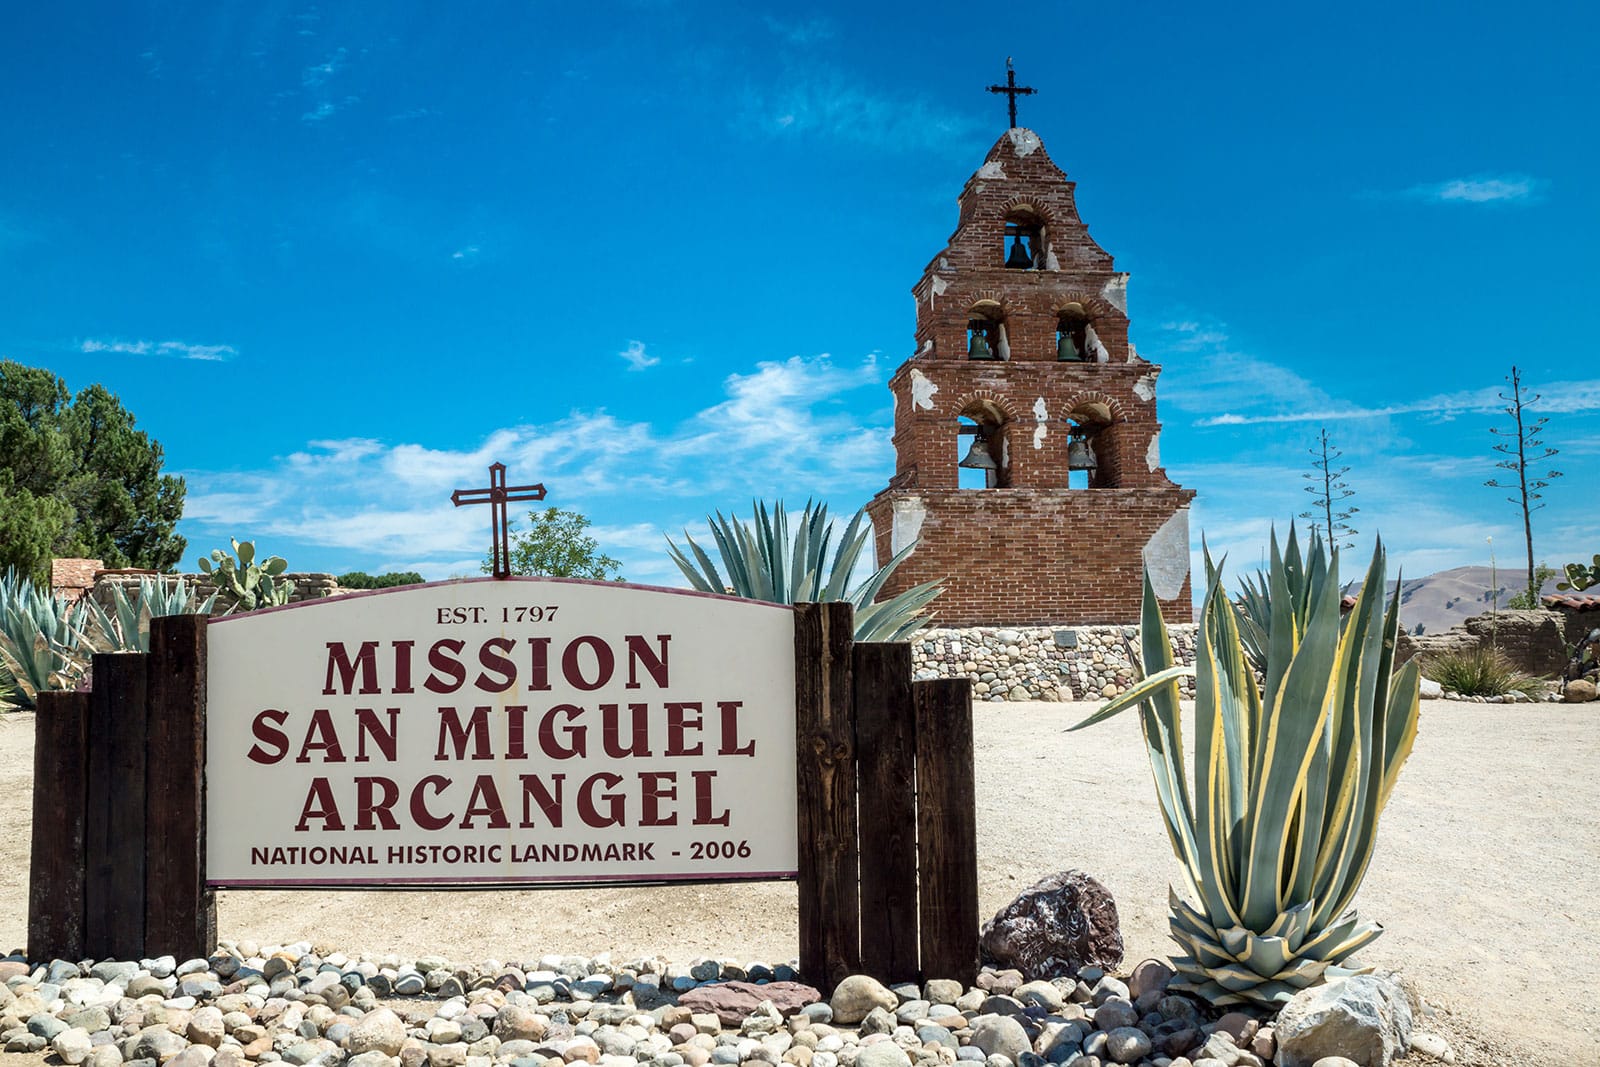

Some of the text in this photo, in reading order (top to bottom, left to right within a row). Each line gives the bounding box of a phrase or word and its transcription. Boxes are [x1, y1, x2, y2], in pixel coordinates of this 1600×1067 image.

[437, 605, 560, 625] EST. 1797
[321, 634, 672, 696] MISSION
[246, 700, 757, 765] SAN MIGUEL
[294, 769, 732, 833] ARCANGEL
[251, 845, 380, 866] NATIONAL
[387, 844, 503, 865] HISTORIC
[510, 842, 656, 863] LANDMARK
[689, 839, 752, 860] 2006
